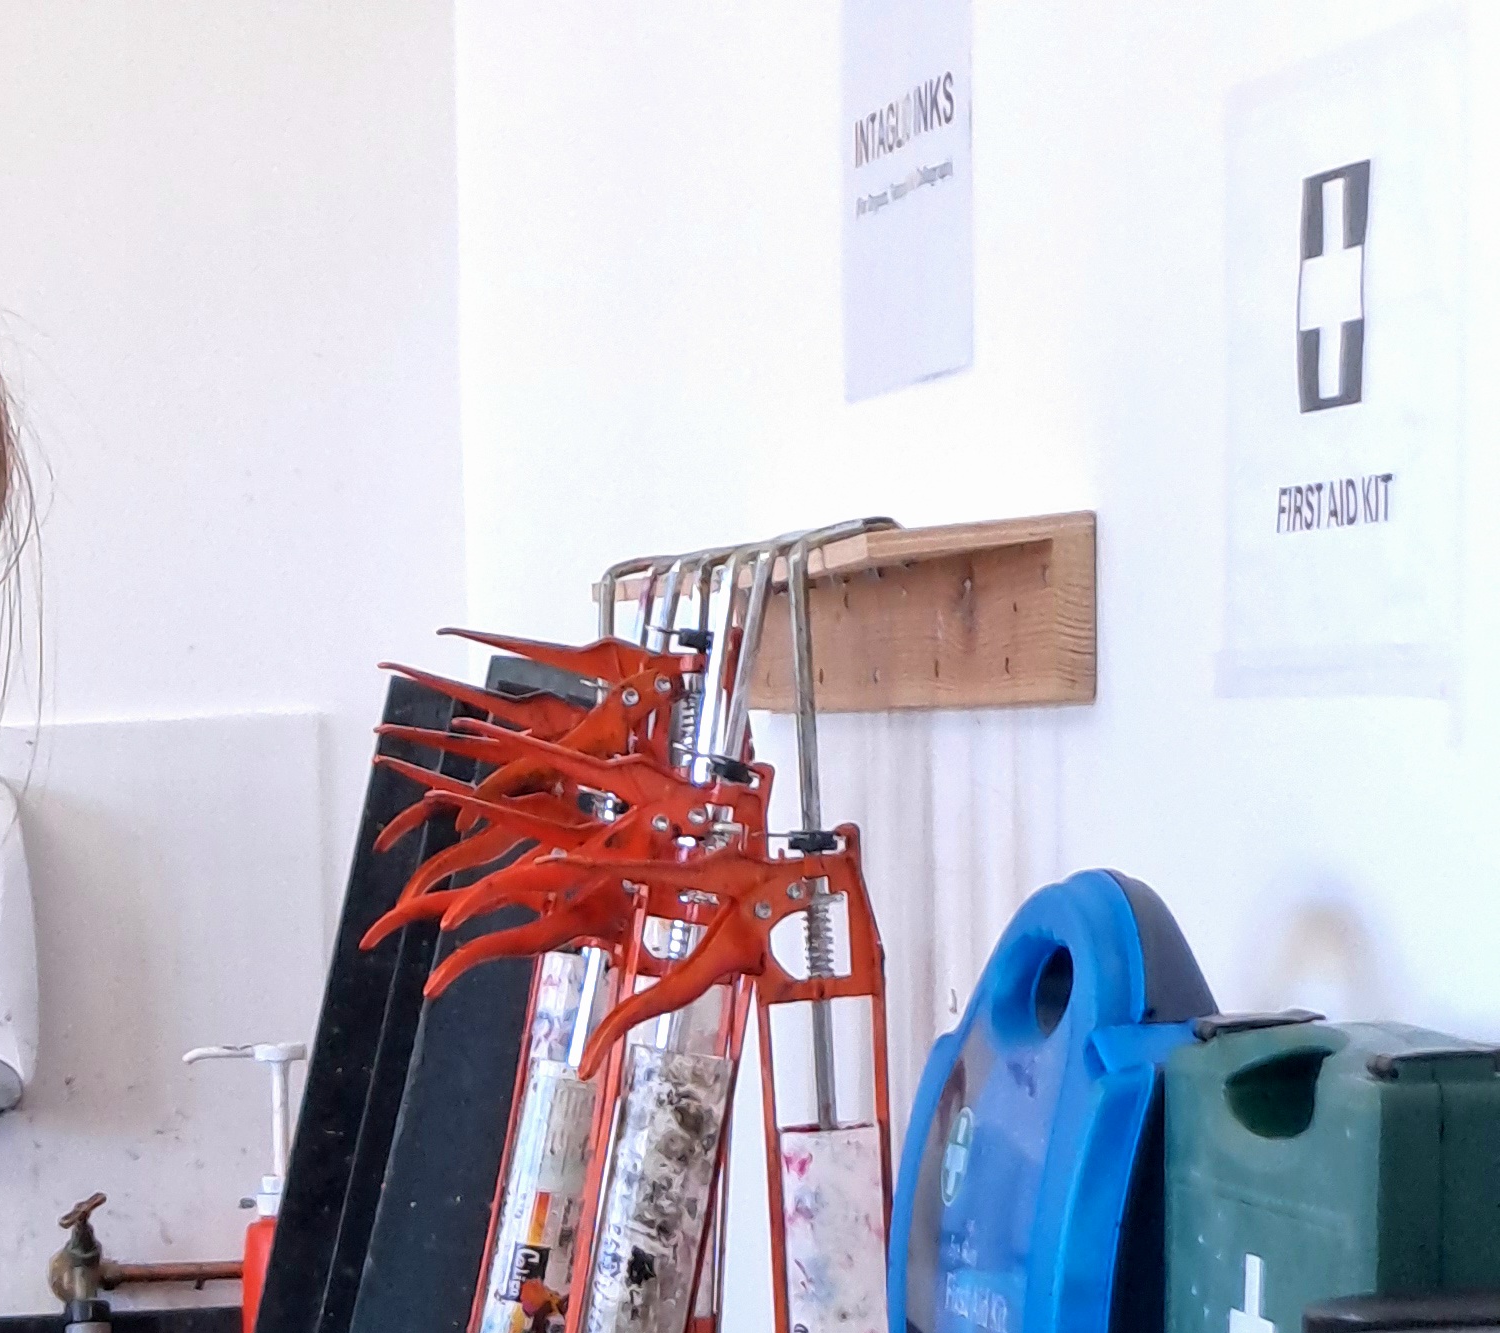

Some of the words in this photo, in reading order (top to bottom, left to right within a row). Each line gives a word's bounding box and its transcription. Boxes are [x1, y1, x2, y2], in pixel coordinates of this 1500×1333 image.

[1277, 482, 1323, 533] FIRST
[1327, 478, 1358, 529] AID
[1362, 474, 1393, 523] KIT
